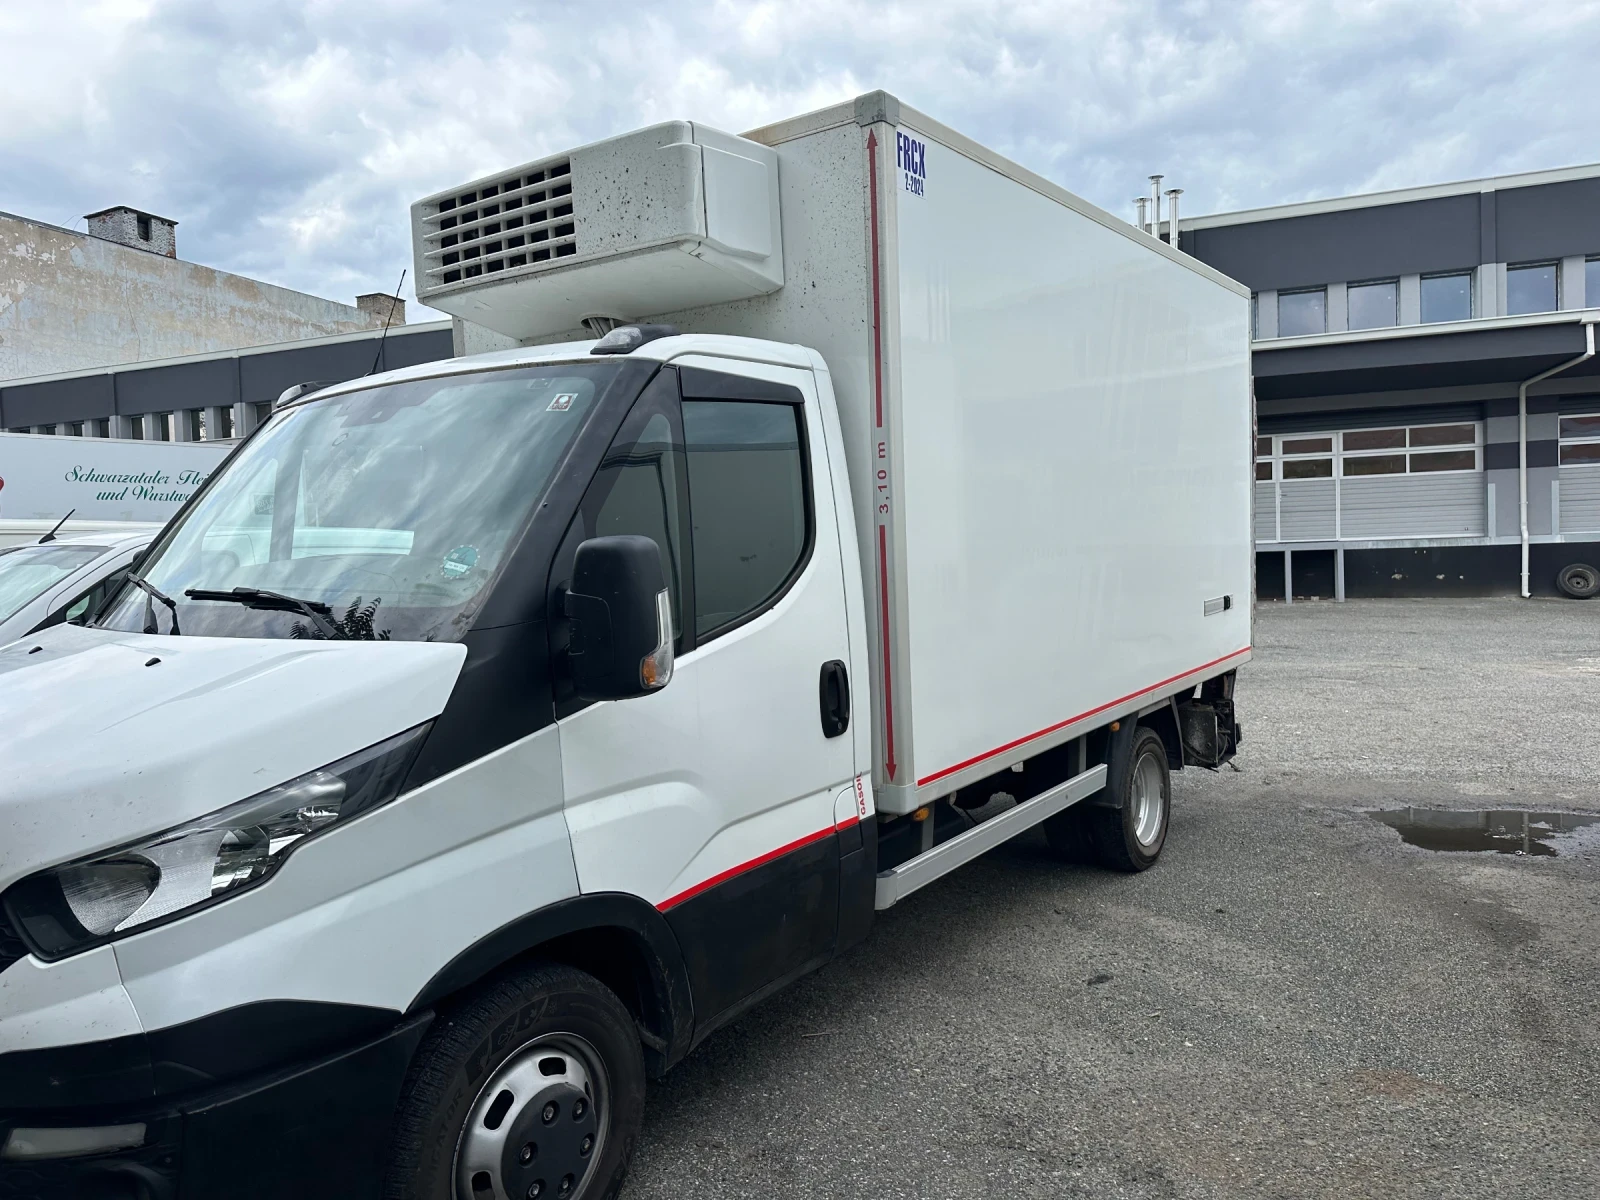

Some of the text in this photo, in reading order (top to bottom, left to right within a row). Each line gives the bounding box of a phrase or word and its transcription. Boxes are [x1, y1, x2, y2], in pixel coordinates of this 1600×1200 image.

[896, 131, 925, 179] FRCX
[905, 172, 923, 196] 2-2024
[64, 464, 171, 485] Schwarzataler
[876, 442, 890, 514] 3,10 m
[95, 486, 129, 501] und
[856, 772, 866, 815] GASOIL
